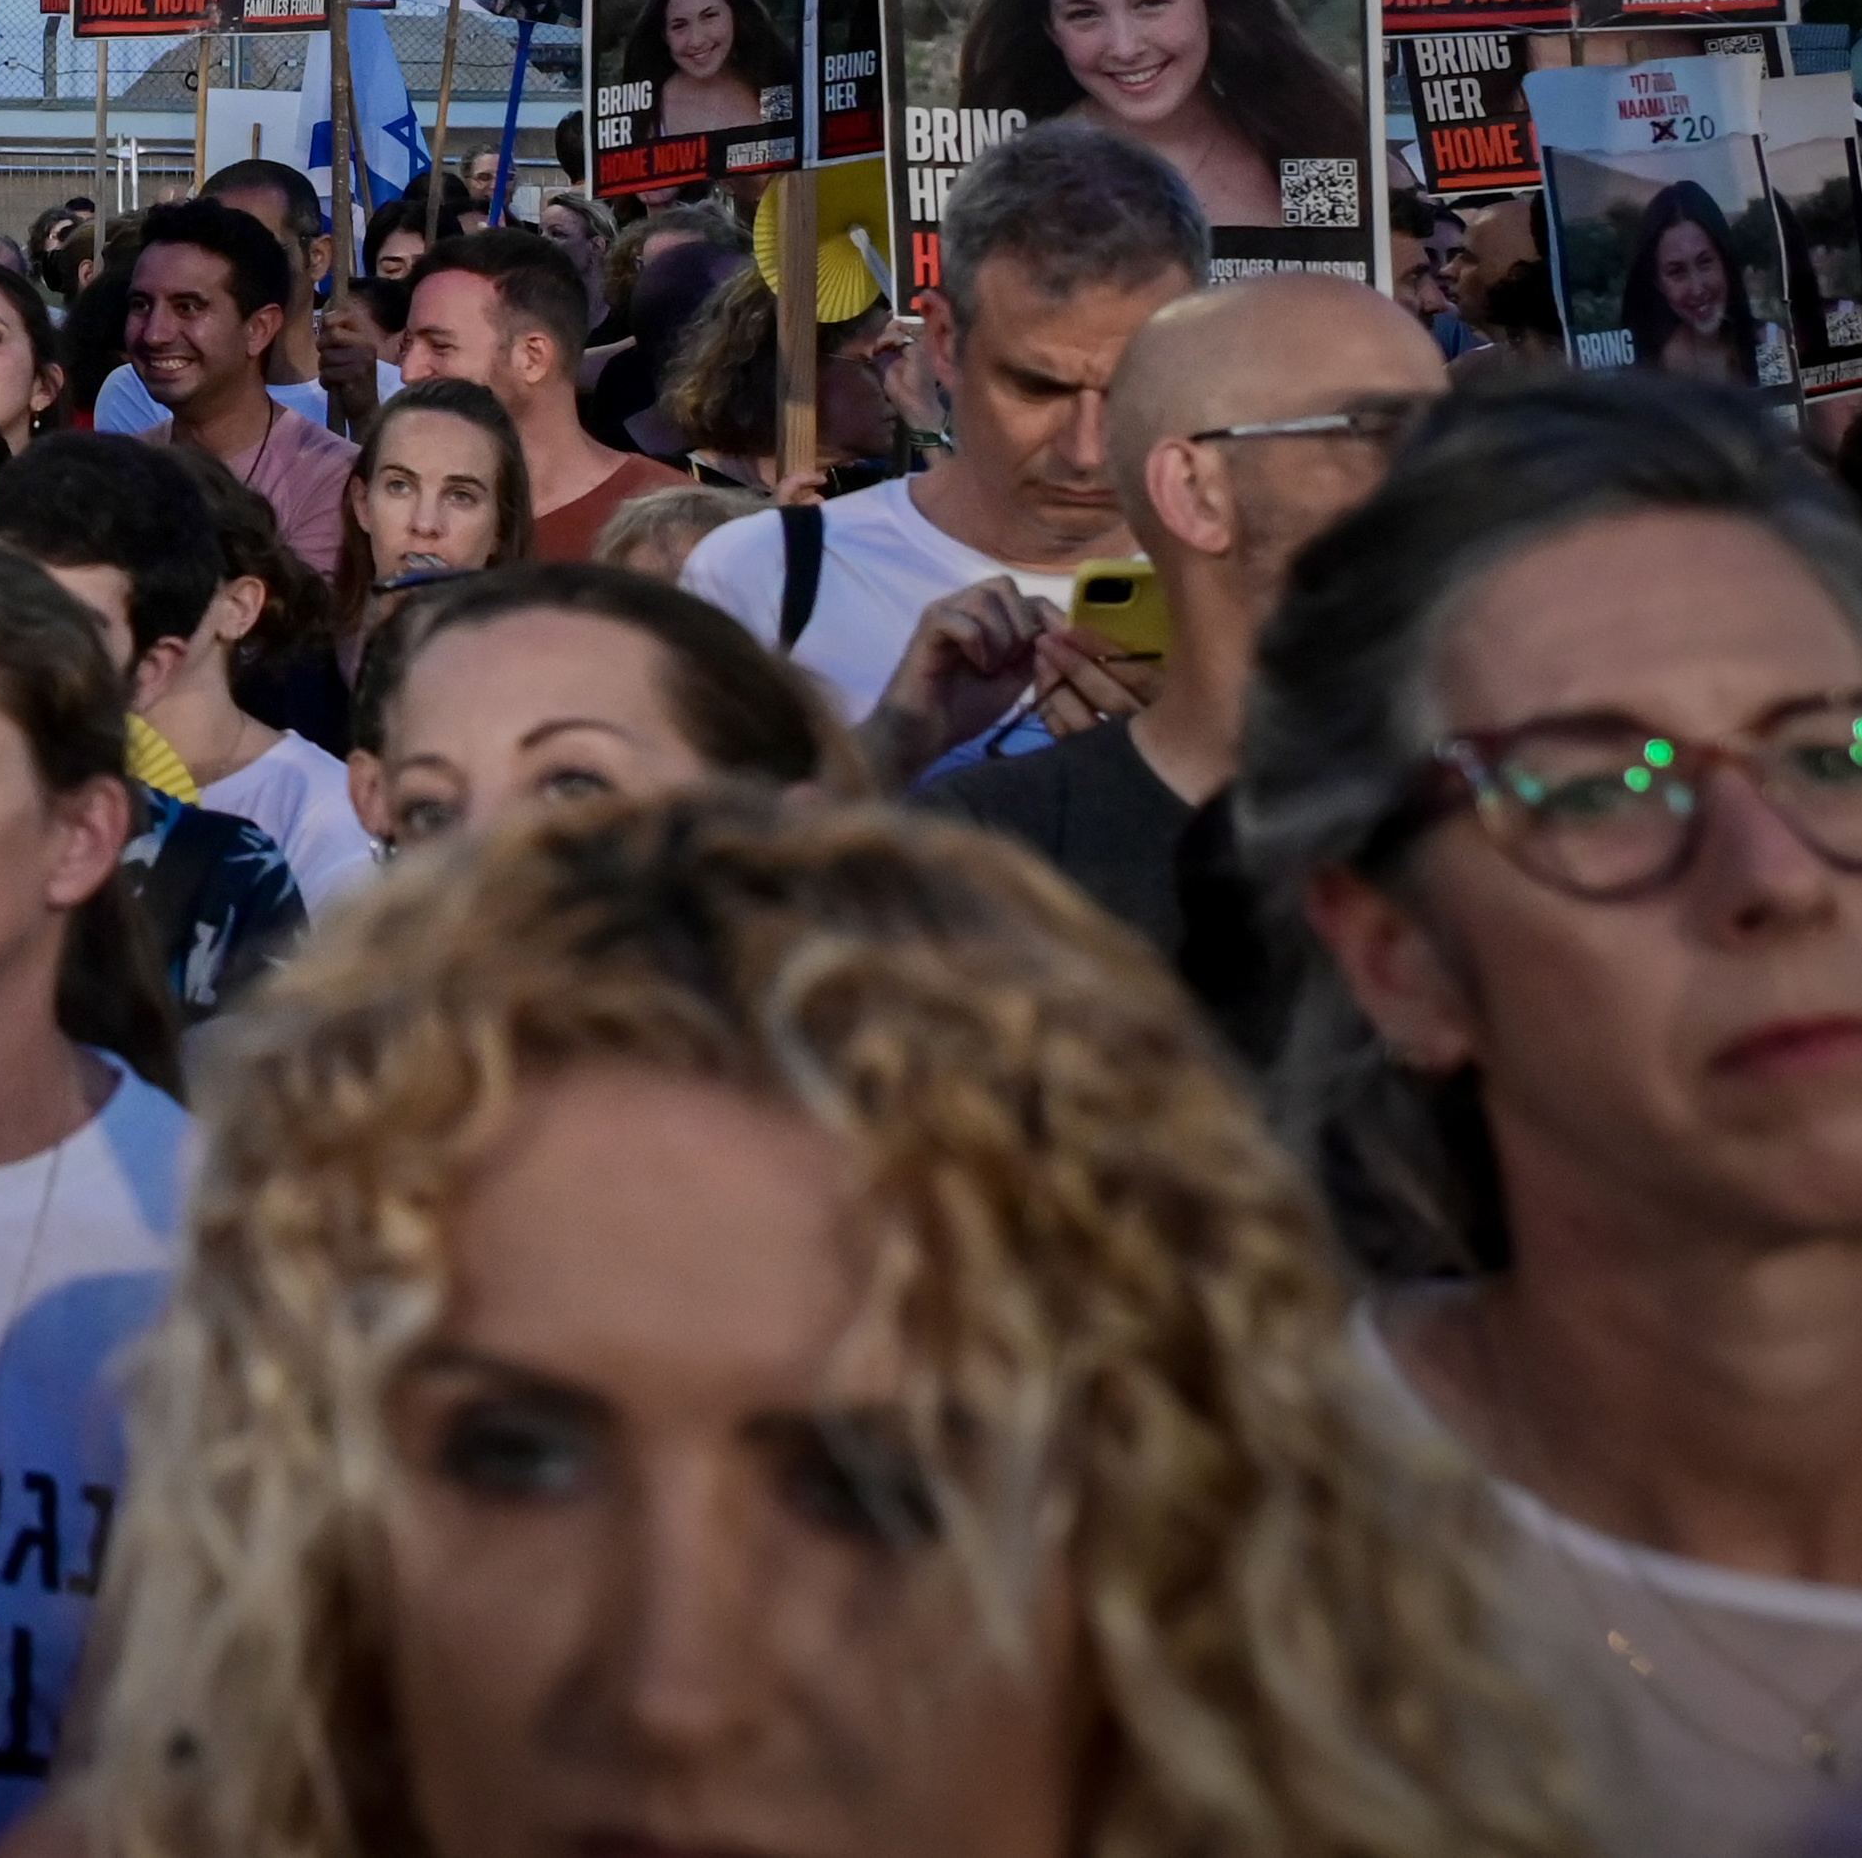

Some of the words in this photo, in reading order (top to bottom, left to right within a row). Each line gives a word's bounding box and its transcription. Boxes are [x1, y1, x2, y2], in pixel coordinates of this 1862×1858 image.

[825, 50, 876, 83] BRING
[1414, 36, 1511, 78] BRING
[597, 81, 652, 118] BRING
[825, 82, 856, 112] HER
[1421, 78, 1486, 122] HER
[598, 116, 632, 149] HER
[1431, 123, 1523, 172] HOME
[1683, 115, 1716, 142] 20
[600, 146, 647, 184] HOME
[655, 136, 707, 173] NOW!
[1578, 329, 1635, 370] BRING
